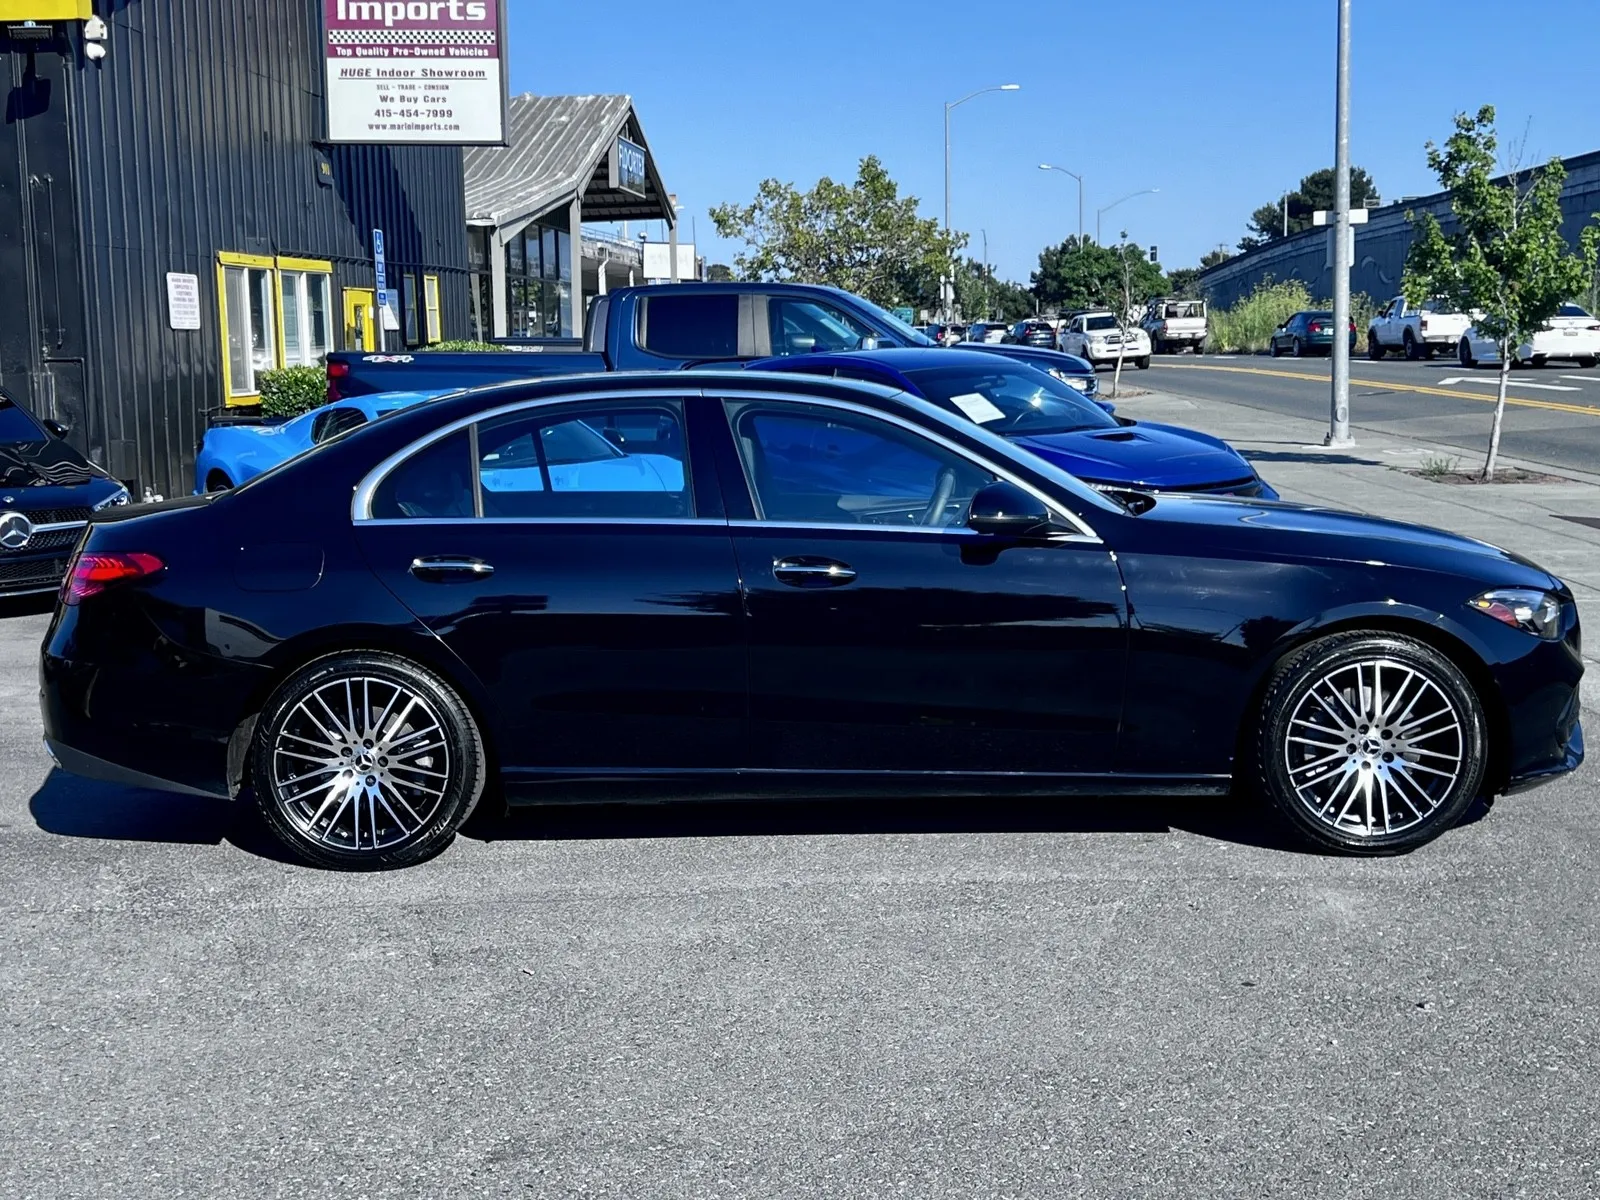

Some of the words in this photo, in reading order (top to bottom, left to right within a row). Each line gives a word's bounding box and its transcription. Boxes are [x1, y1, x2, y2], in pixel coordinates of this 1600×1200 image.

[337, 0, 486, 27] Imports
[336, 47, 352, 57] Top
[355, 47, 390, 57] Quality
[393, 47, 446, 57] Pre-Owned
[450, 47, 489, 57] Vehicles
[340, 68, 372, 77] HUGE
[376, 68, 415, 77] Indoor
[421, 68, 486, 78] Showroom
[379, 95, 395, 103] We
[399, 95, 418, 104] Buy
[423, 95, 447, 103] Cars
[374, 109, 453, 118] 415-454-7999
[367, 122, 460, 131] www.marinimports.com
